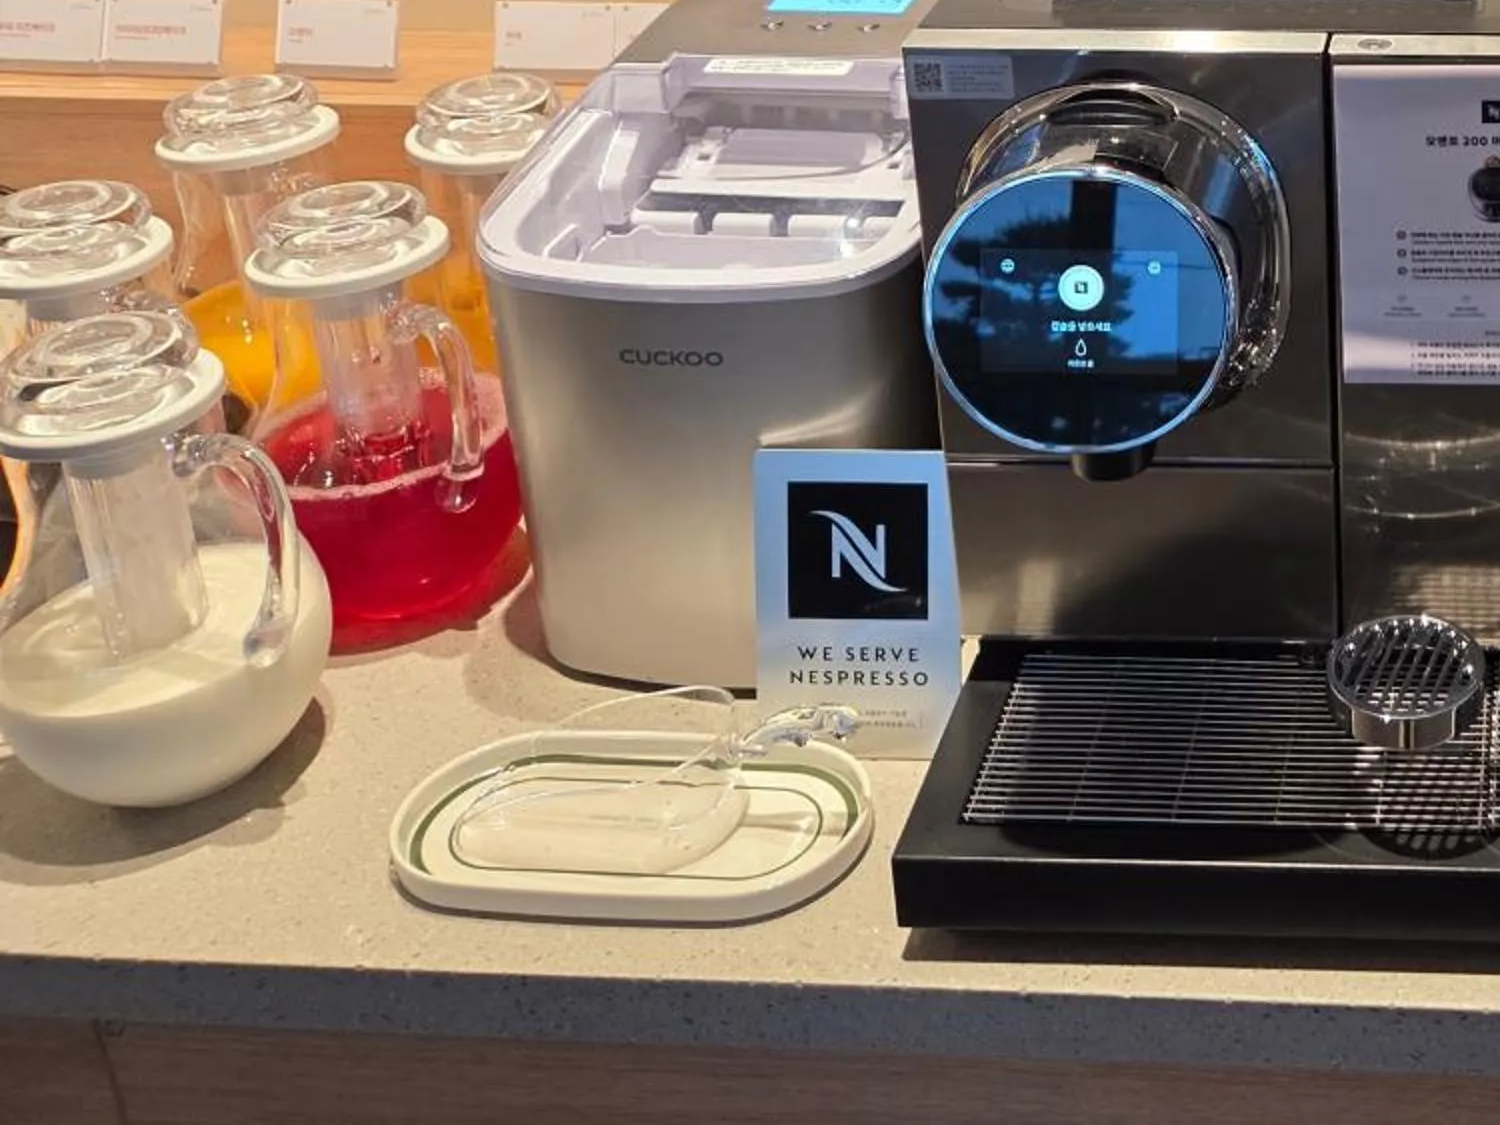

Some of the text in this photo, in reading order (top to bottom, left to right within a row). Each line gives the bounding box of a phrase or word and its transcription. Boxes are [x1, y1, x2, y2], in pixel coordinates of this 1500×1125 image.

[1463, 136, 1489, 147] 200
[619, 349, 724, 367] CUCKOO
[798, 646, 920, 663] WE SERVE
[789, 670, 929, 686] NESPRESSO
